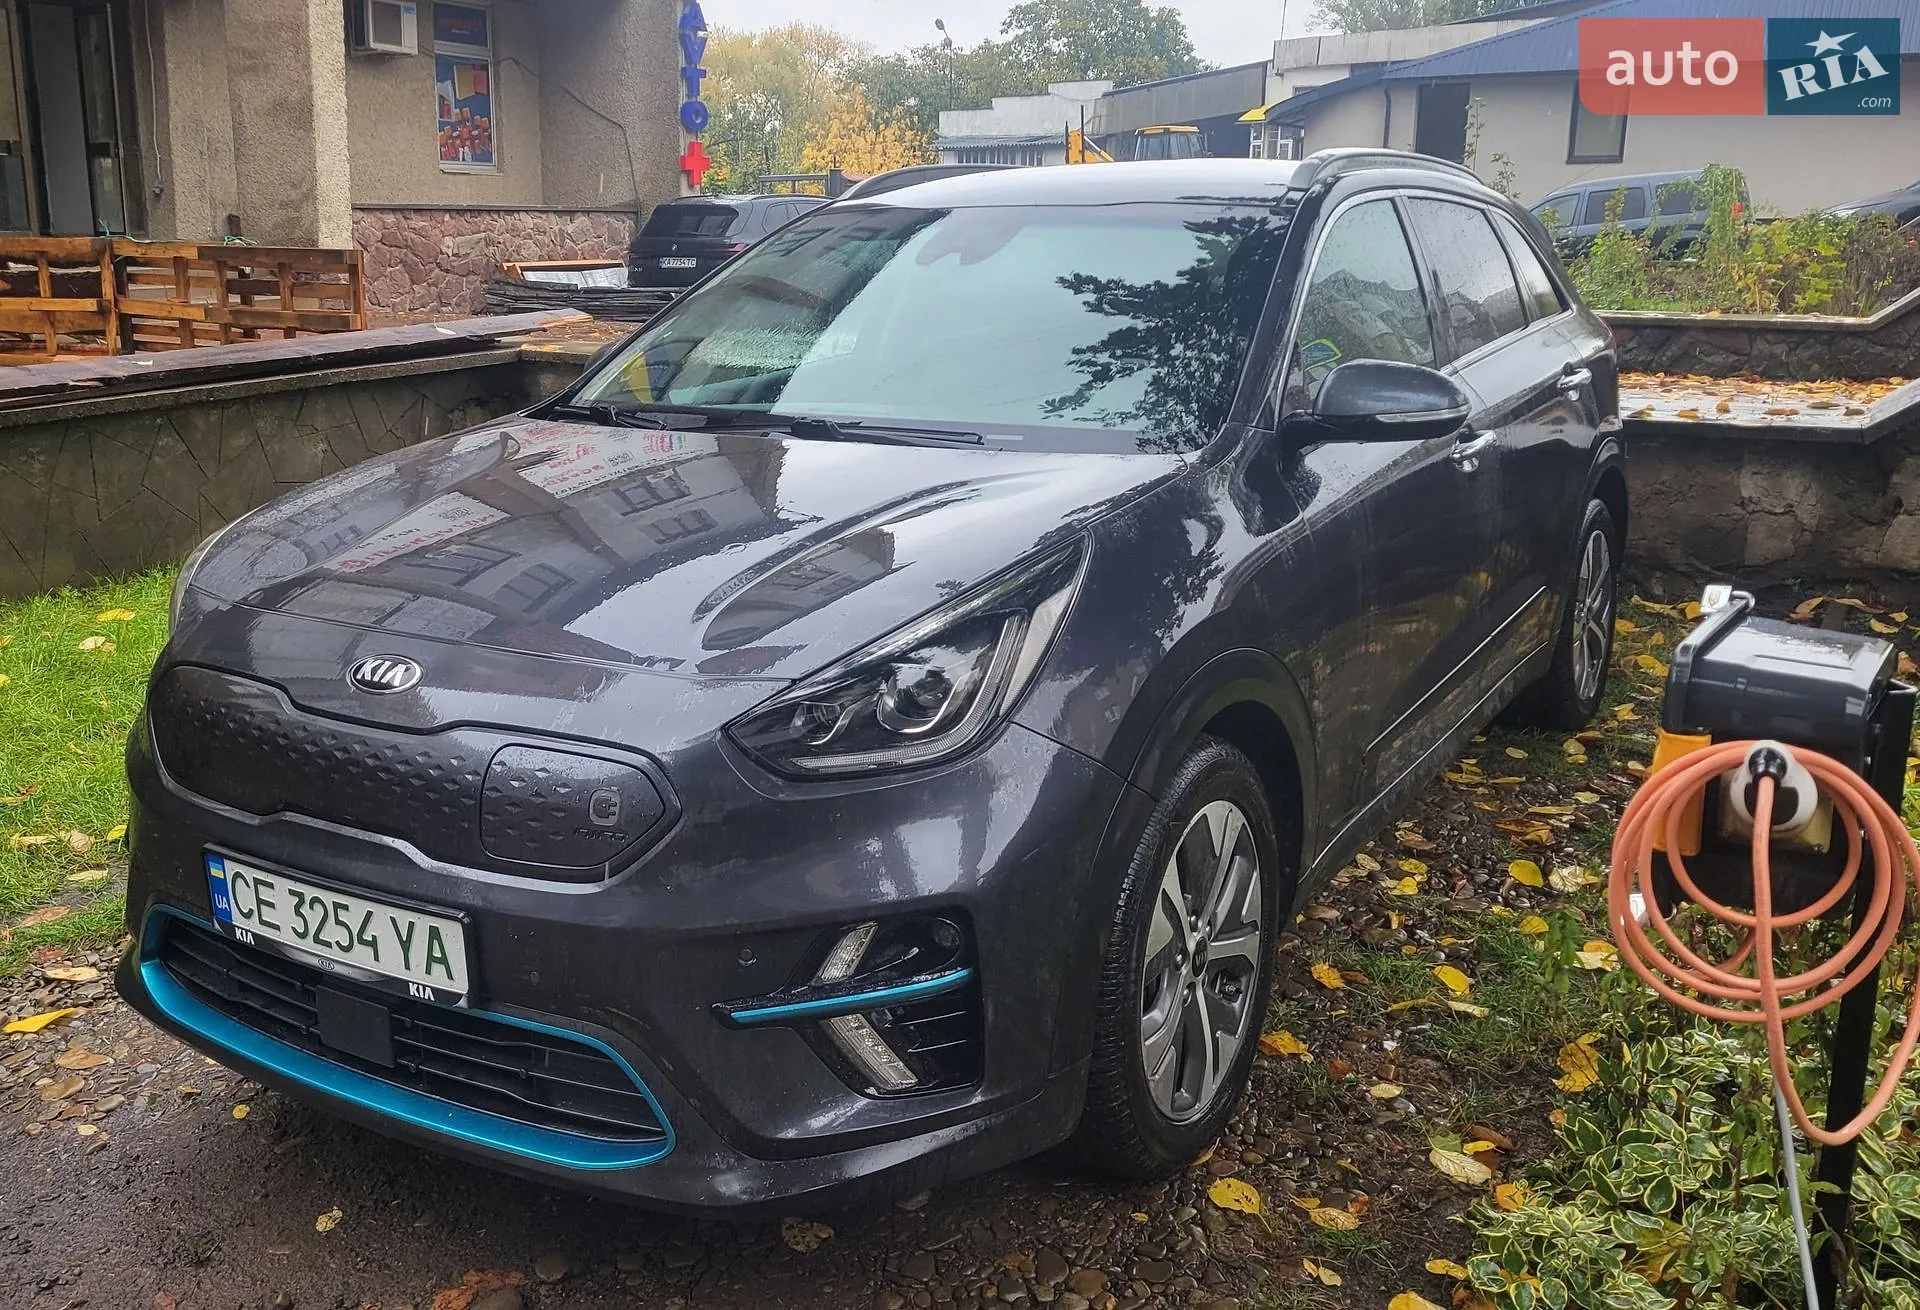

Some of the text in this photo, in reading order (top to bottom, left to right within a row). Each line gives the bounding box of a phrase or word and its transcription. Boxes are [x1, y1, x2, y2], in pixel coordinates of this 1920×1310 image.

[355, 659, 402, 687] KIA
[215, 893, 230, 911] UA
[231, 870, 454, 981] CE 3254 YA
[234, 926, 255, 945] KIA
[408, 982, 435, 1001] KIA
